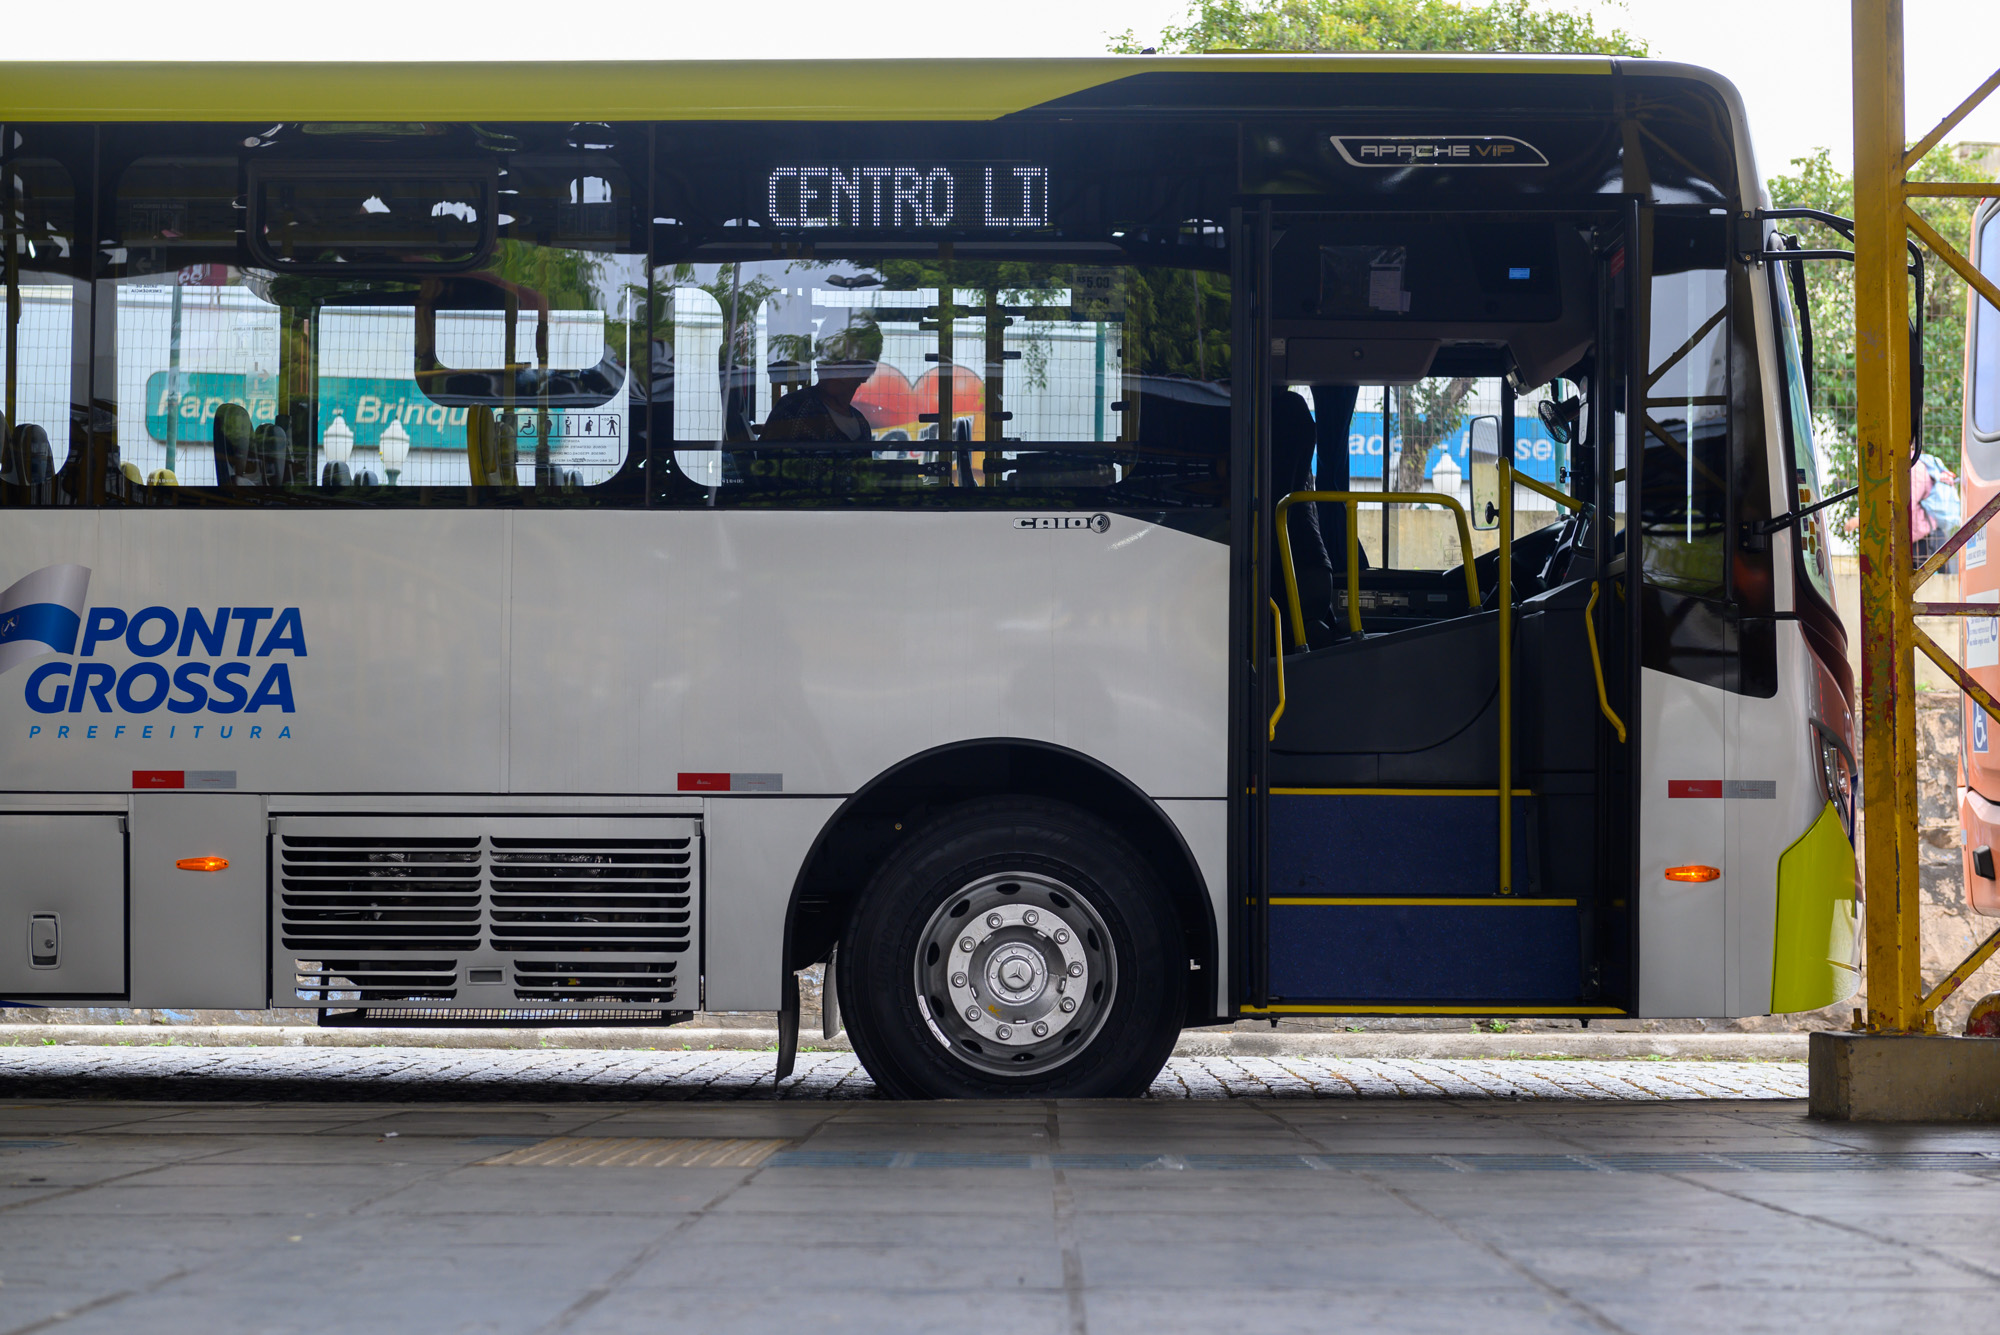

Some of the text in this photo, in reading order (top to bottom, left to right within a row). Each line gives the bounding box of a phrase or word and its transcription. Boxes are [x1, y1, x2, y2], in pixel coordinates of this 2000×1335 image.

[1360, 145, 1515, 157] APACHE VIP
[769, 167, 954, 227] CENTRO
[1013, 516, 1091, 530] CAIO
[80, 606, 308, 658] PONTA
[25, 662, 296, 714] GROSSA
[29, 726, 292, 739] PREFEITURA
